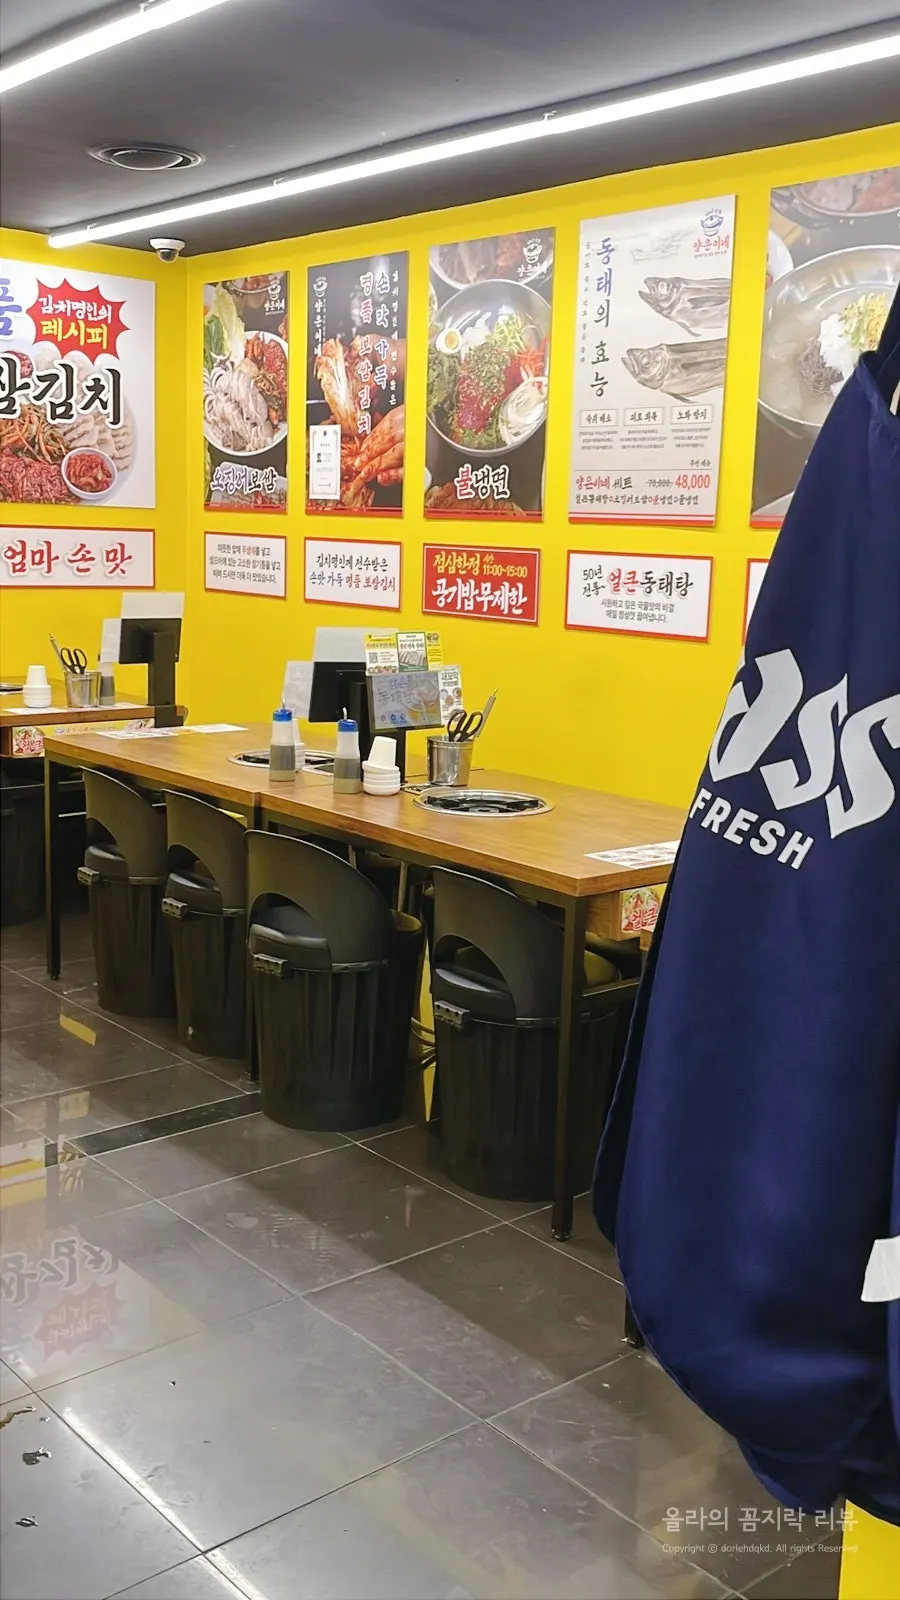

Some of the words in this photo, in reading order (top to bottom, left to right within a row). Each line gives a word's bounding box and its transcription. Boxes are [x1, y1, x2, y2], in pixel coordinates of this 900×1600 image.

[38, 295, 113, 324] 김치명인의
[41, 318, 109, 351] 레시피
[590, 340, 610, 397] 효능
[211, 467, 278, 494] 오징어보쌈
[456, 465, 509, 498] 불냉면
[675, 474, 711, 490] 48,000
[4, 540, 60, 574] 엄마
[67, 543, 96, 573] 손
[105, 542, 132, 575] 맛
[355, 556, 388, 572] 전수받은
[433, 551, 480, 576] 점심한정
[310, 571, 326, 585] 손맛
[327, 572, 344, 587] 가득
[345, 574, 361, 588] 명품
[363, 576, 396, 592] 보쌈김치
[583, 565, 602, 580] 50년
[432, 578, 529, 615] 공기밥무제한
[689, 787, 814, 870] FRESH
